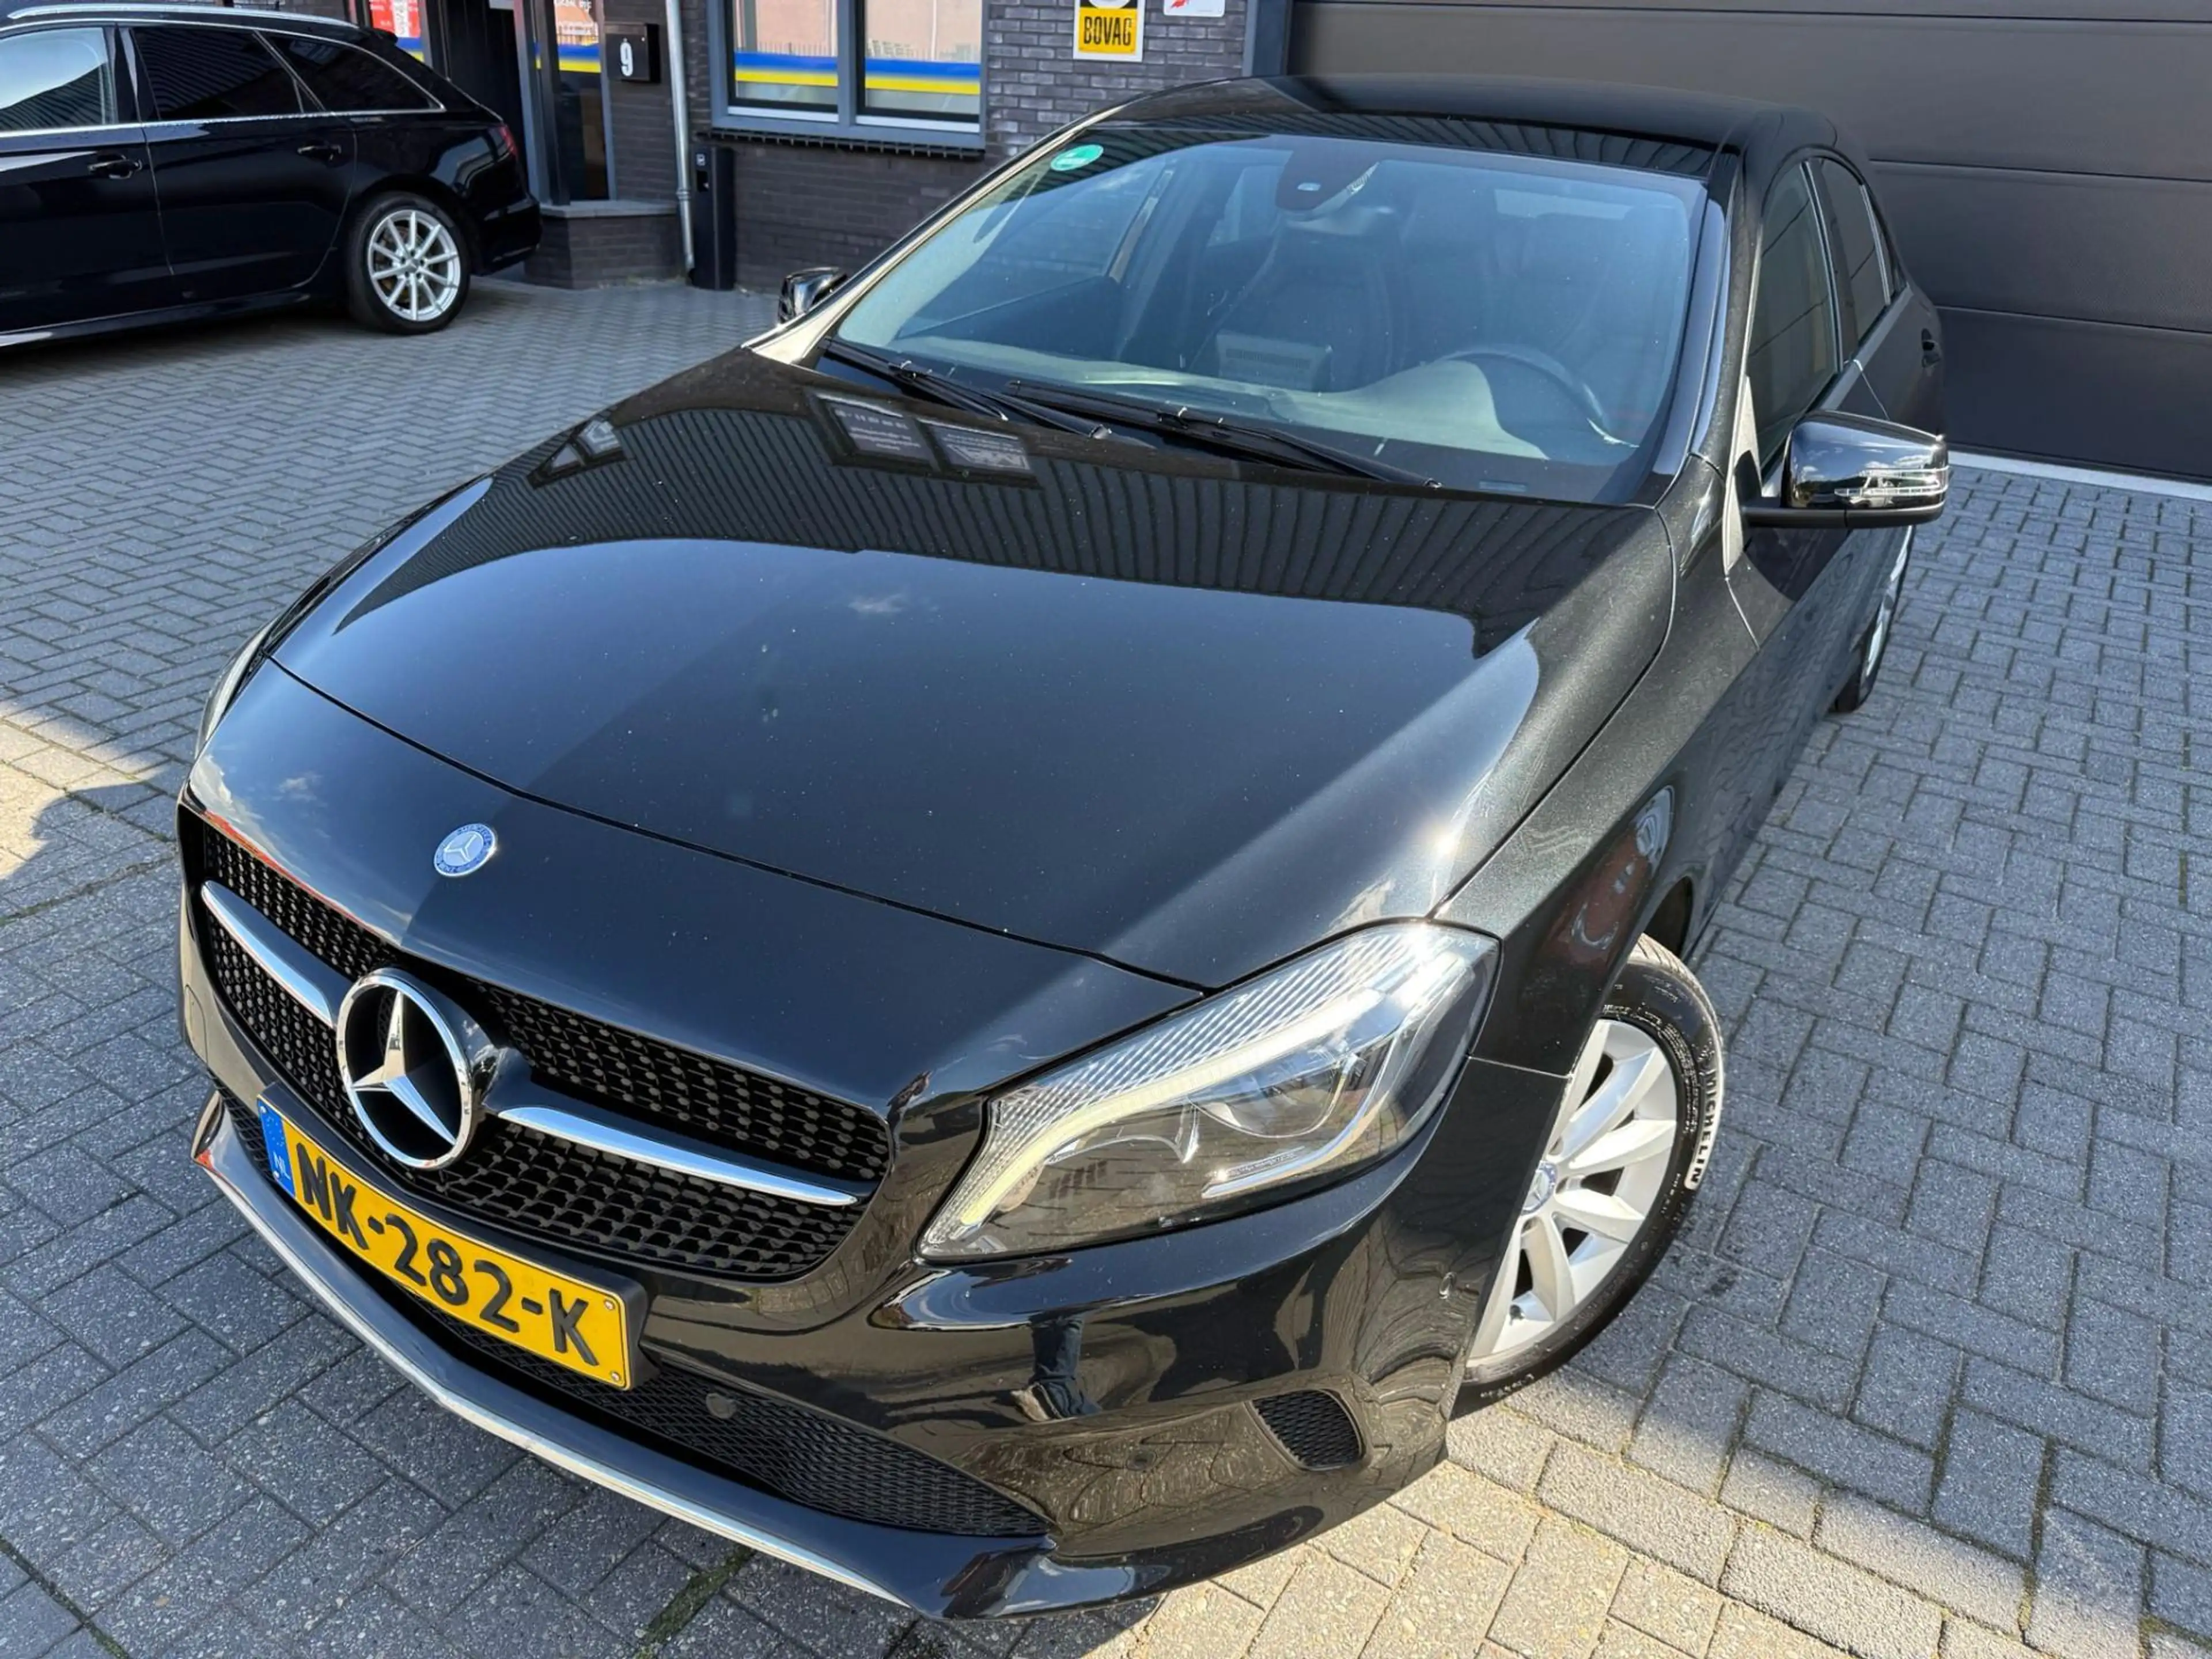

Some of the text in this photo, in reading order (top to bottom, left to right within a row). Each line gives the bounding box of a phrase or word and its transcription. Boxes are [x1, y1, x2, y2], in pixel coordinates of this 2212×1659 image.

[1084, 16, 1132, 46] BOVAG
[620, 41, 633, 76] 9
[1691, 1070, 1717, 1183] MICHELIN
[272, 1151, 291, 1181] NL
[296, 1142, 600, 1366] NK-282-K
